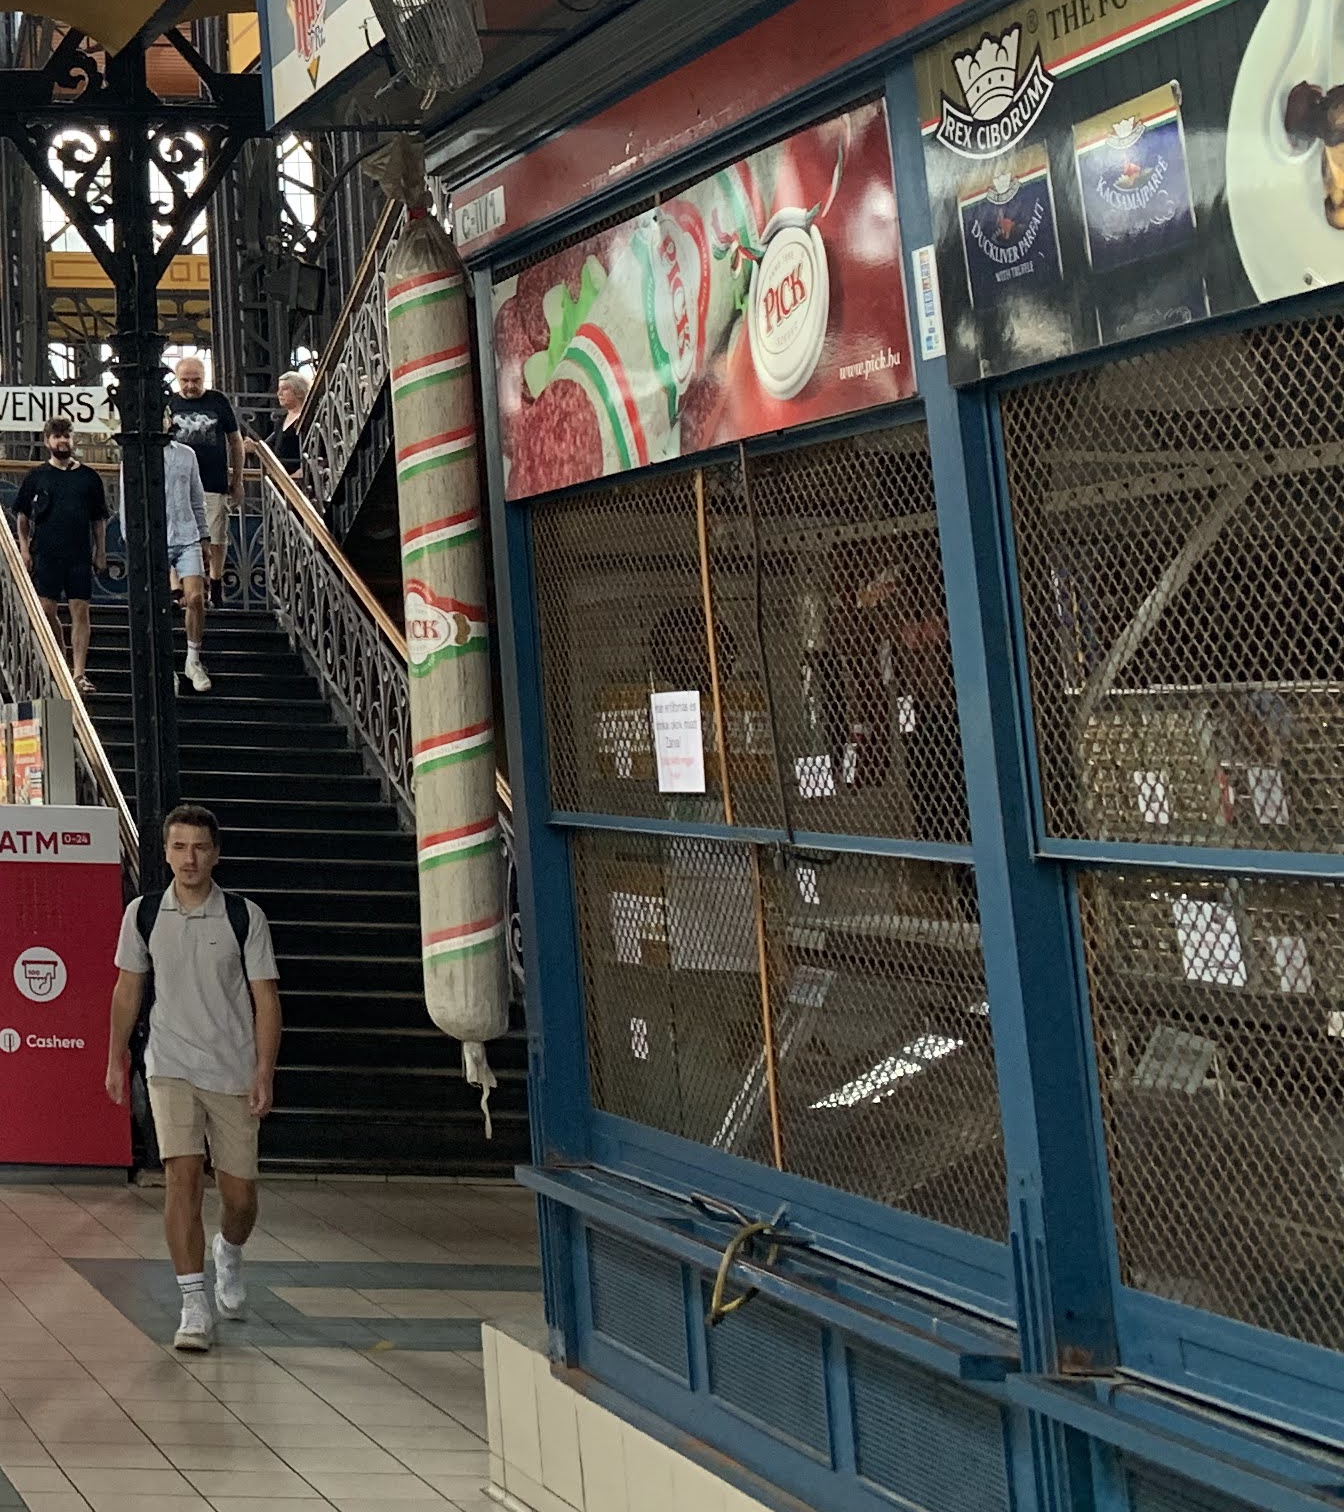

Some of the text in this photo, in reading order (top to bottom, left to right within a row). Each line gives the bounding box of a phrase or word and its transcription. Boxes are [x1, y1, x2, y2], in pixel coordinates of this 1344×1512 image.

[944, 76, 1045, 150] REX CIBORUM
[763, 261, 807, 336] PICK
[838, 346, 902, 381] www.pick.hu
[26, 1033, 85, 1050] Cashere
